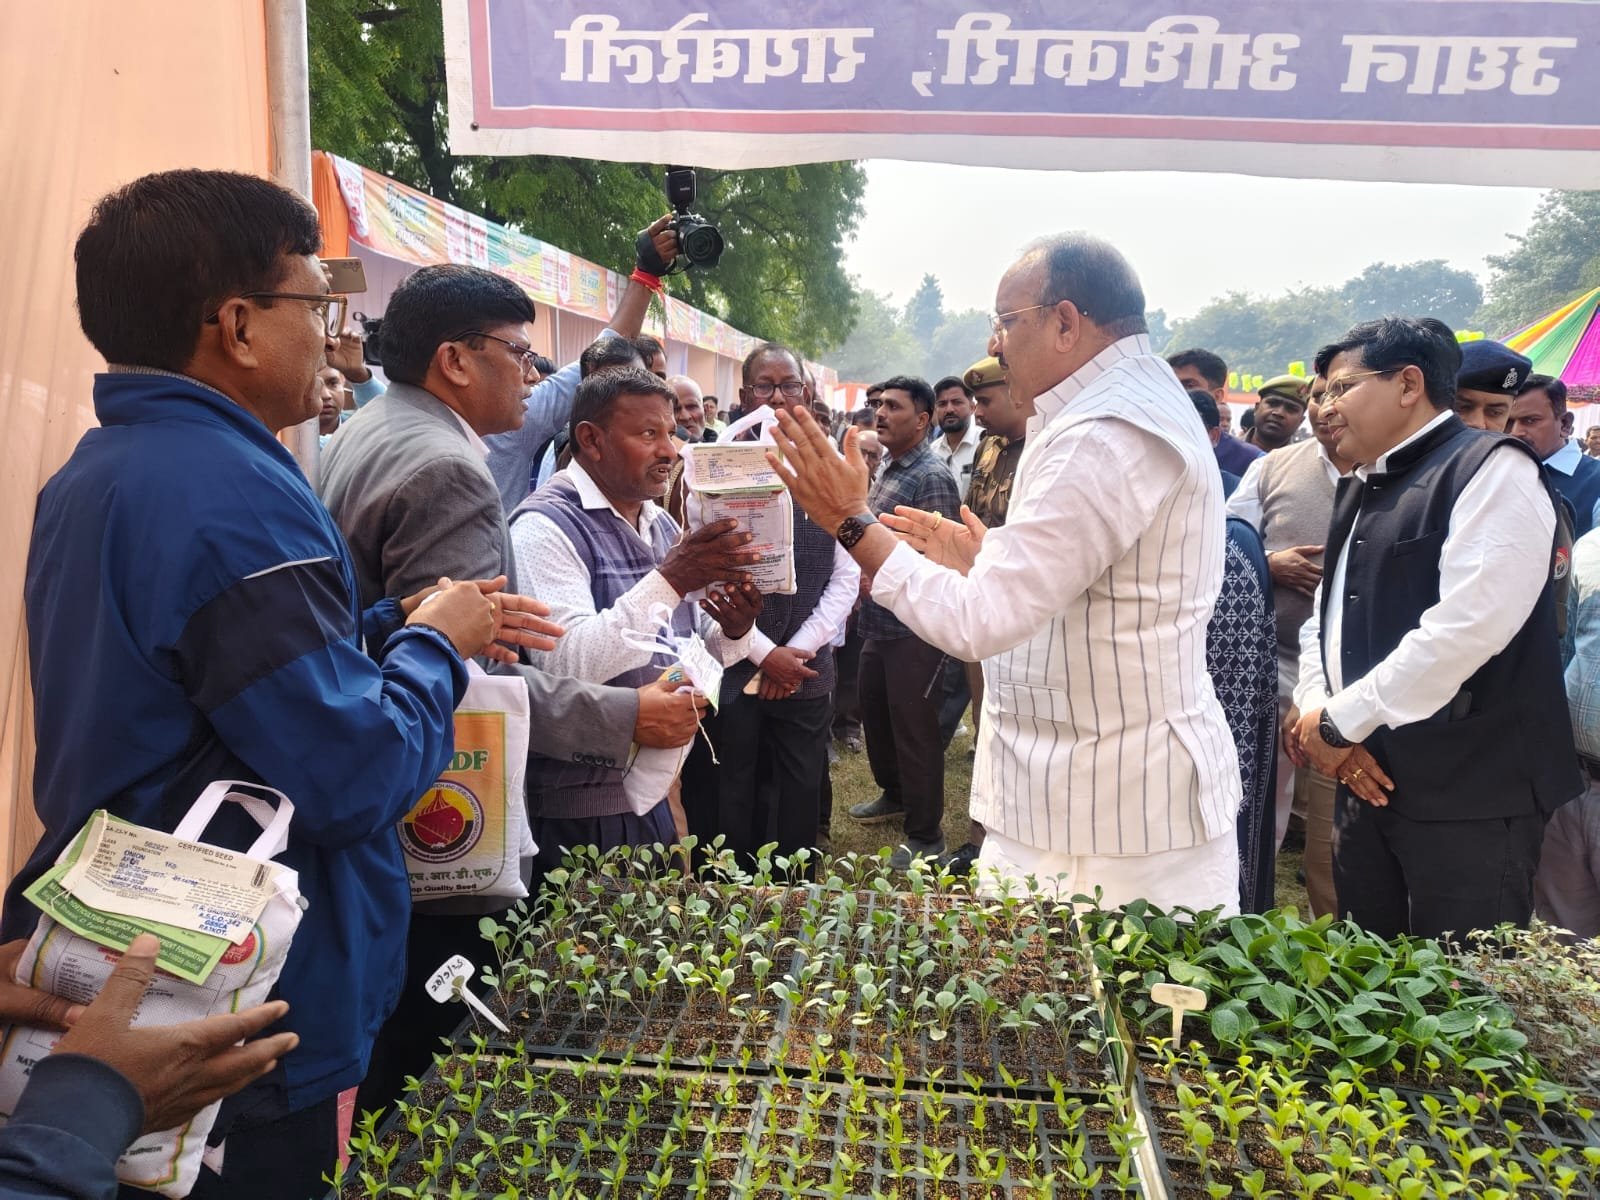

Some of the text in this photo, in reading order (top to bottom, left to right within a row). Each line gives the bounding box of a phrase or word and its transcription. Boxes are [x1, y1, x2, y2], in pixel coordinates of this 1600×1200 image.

[447, 750, 489, 771] DF
[123, 849, 146, 860] ONION
[177, 842, 234, 861] CERTIFIED SEED
[423, 884, 454, 892] Quality
[456, 883, 477, 891] Seed
